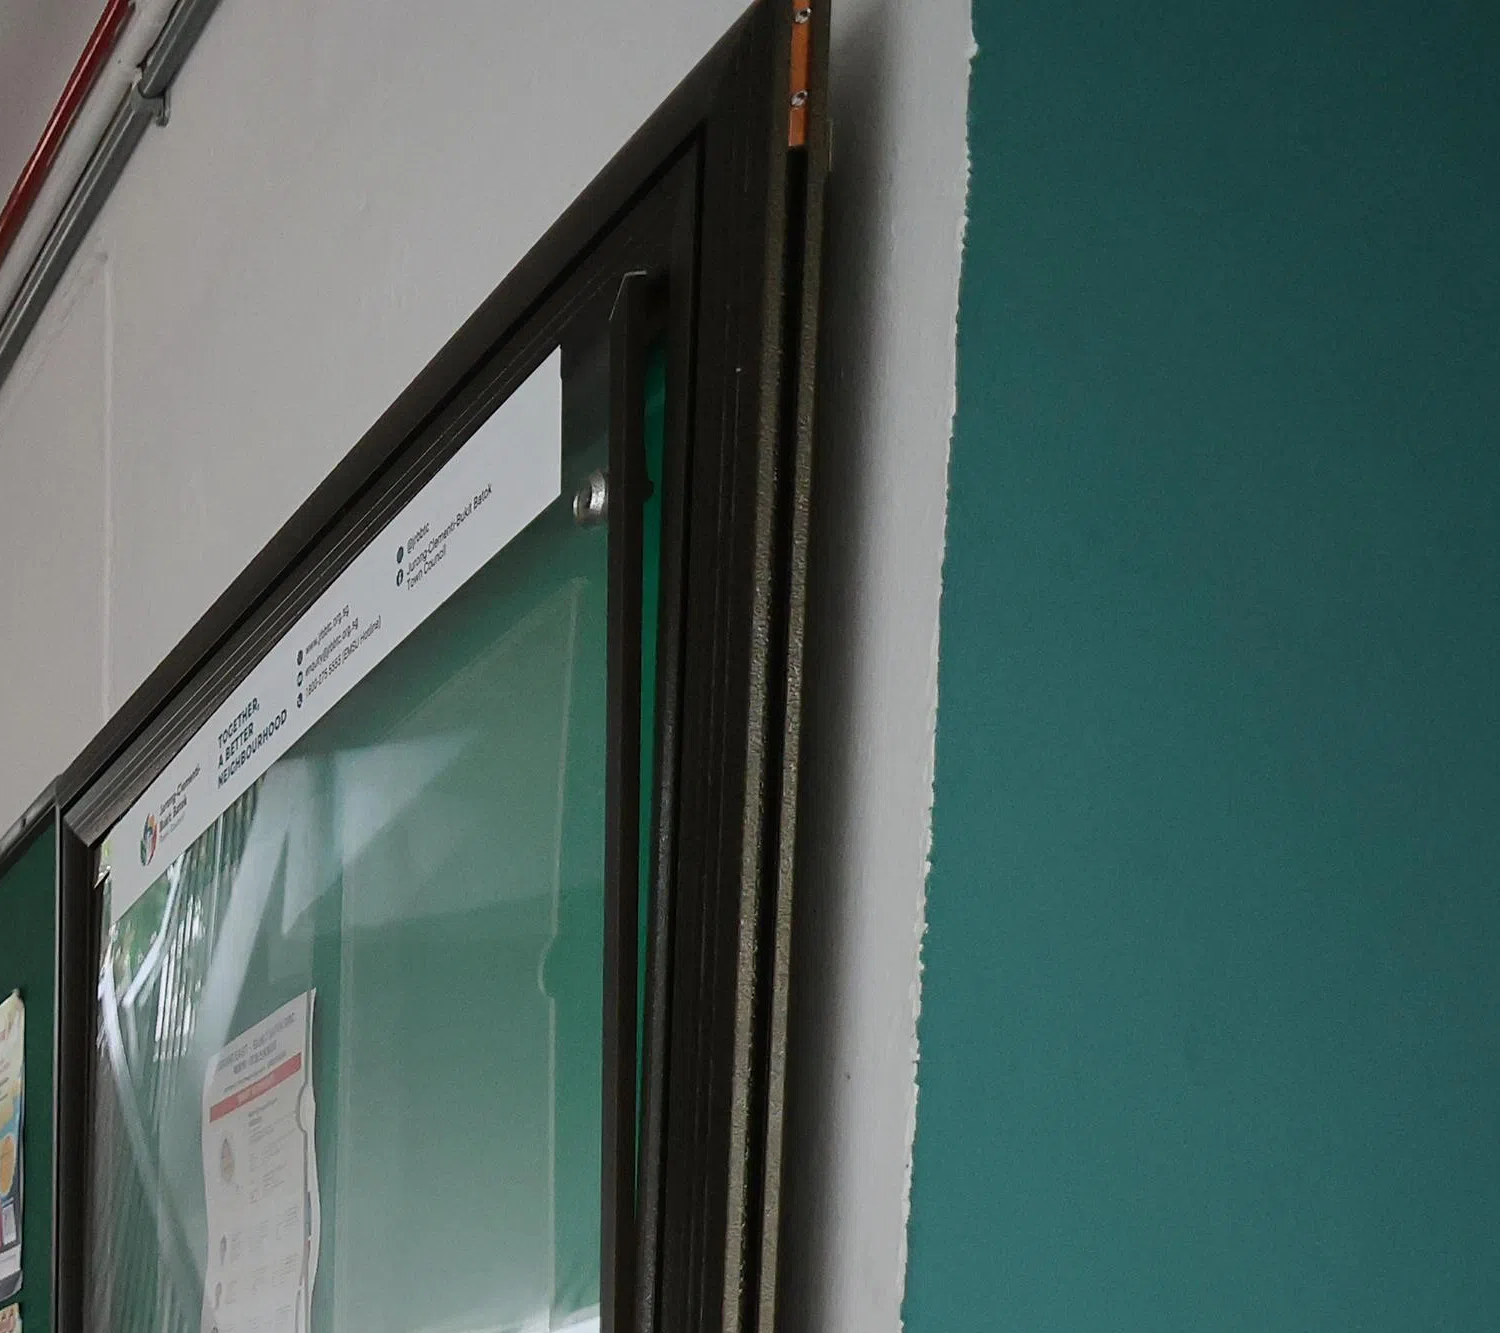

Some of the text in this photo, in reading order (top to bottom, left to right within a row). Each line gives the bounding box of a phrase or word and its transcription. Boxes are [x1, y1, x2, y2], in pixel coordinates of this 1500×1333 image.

[473, 483, 492, 510] Batok
[217, 697, 260, 748] TOGETHER,
[218, 722, 255, 768] A BETTER
[217, 708, 288, 789] NEIGHBOURHOOD
